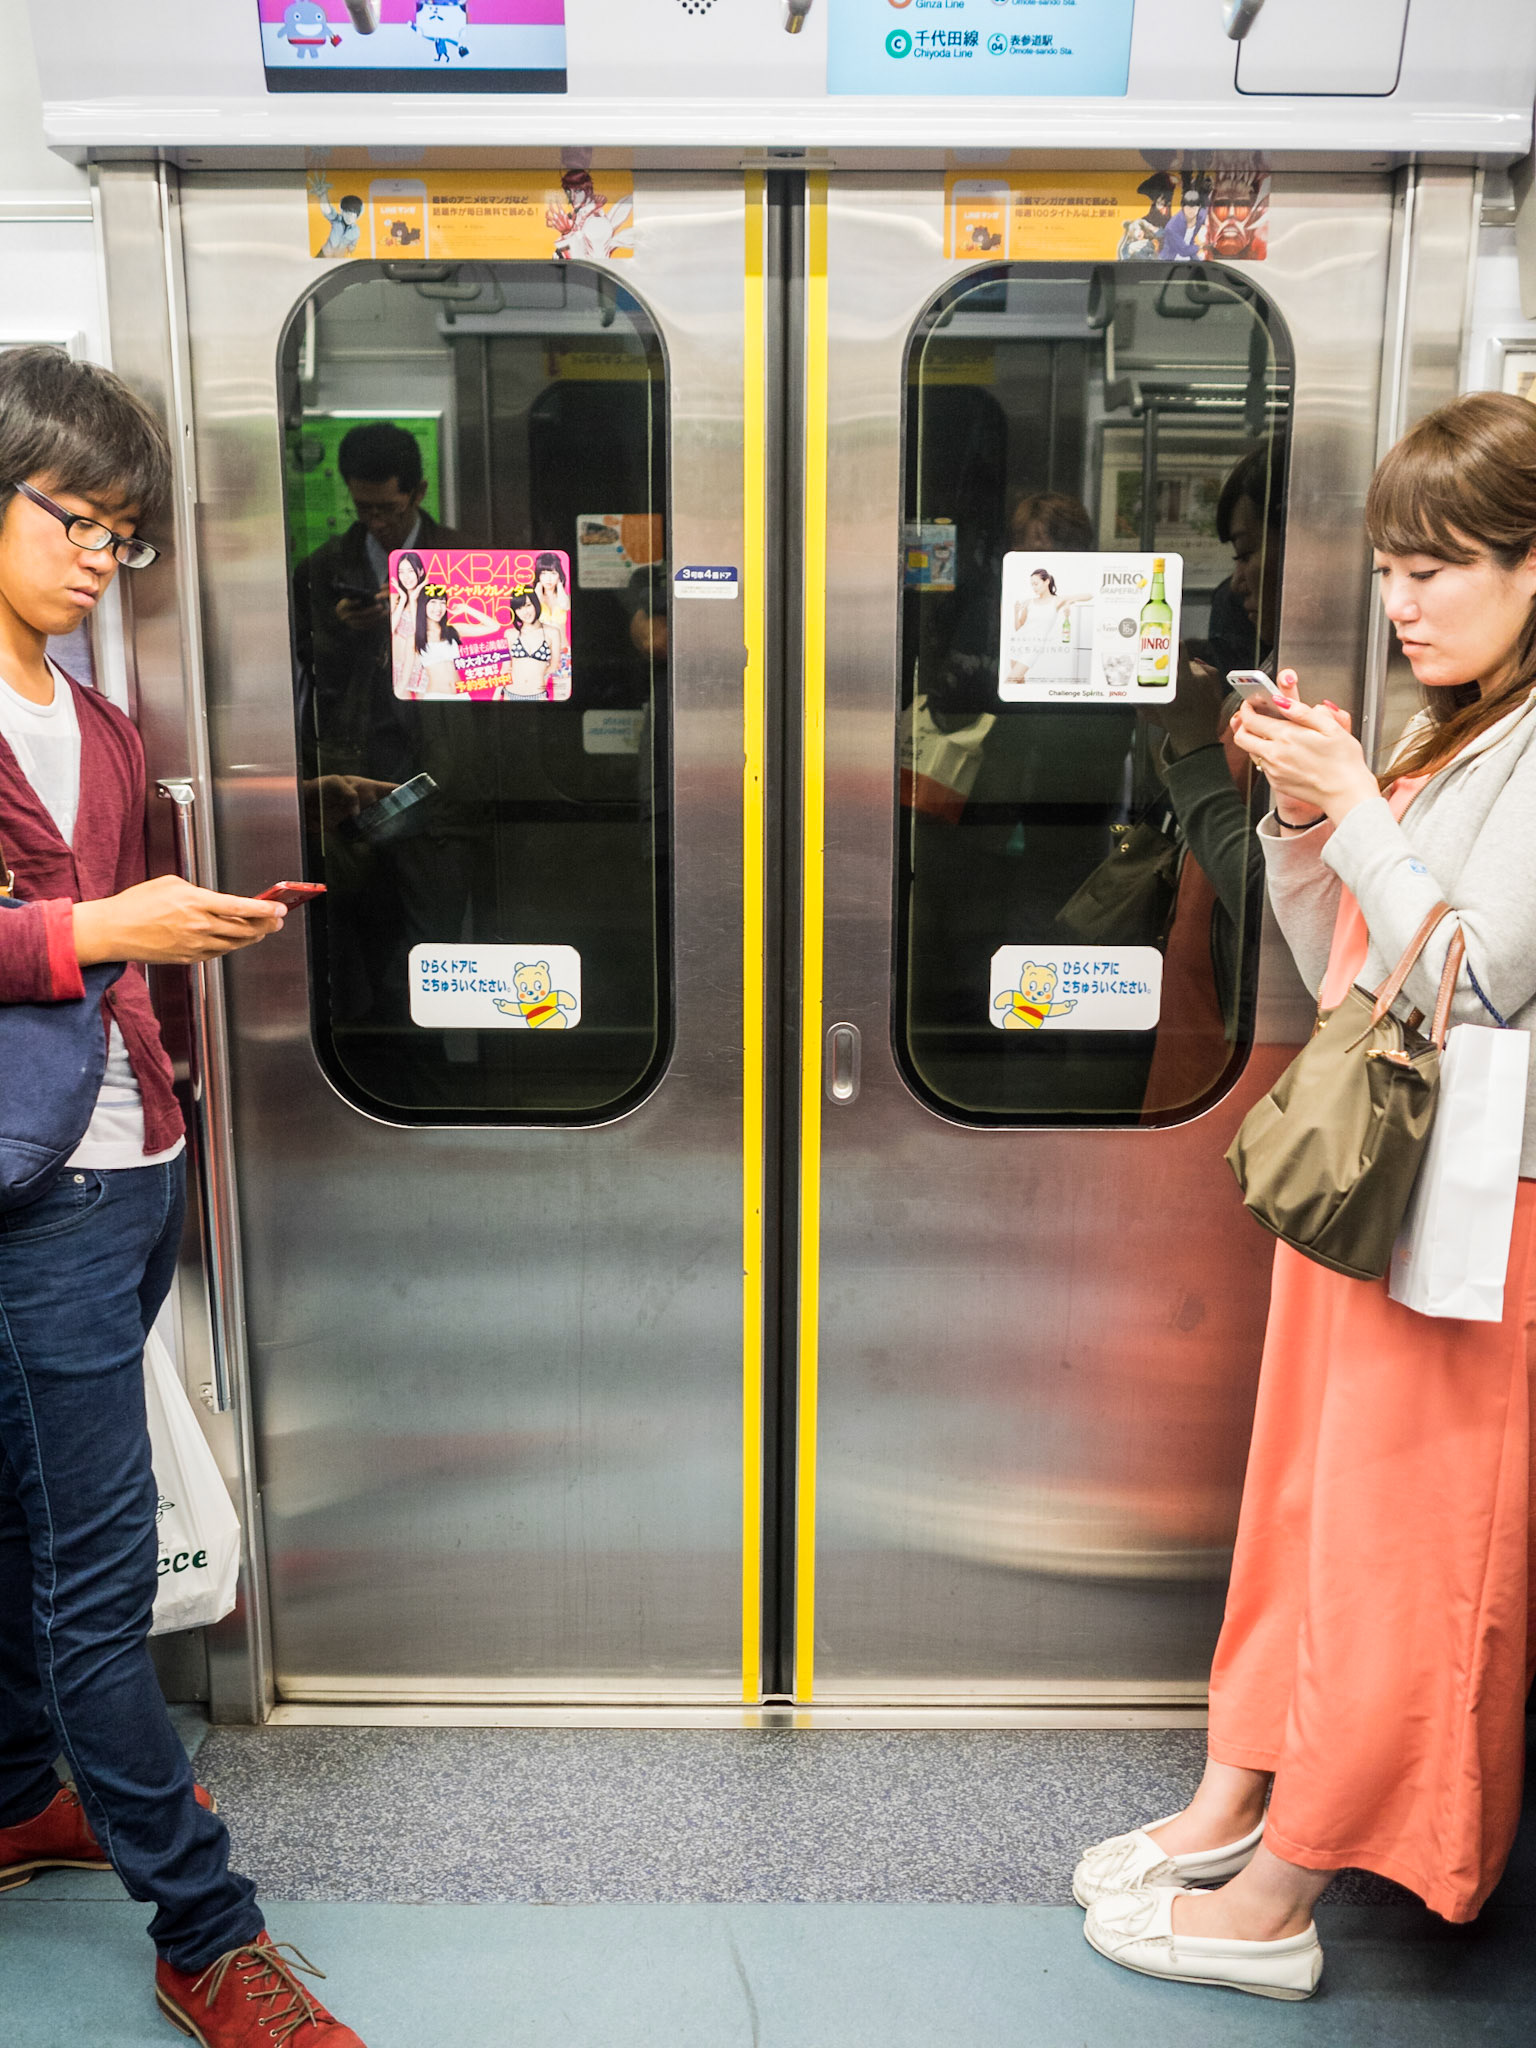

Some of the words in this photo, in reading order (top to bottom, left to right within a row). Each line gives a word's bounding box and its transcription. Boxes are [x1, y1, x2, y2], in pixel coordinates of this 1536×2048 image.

[915, 0, 942, 9] Ginza
[945, 0, 965, 9] Line
[894, 38, 902, 50] C
[914, 30, 979, 47] 千代田線
[1010, 34, 1053, 46] 表参道駅
[991, 42, 1003, 51] 04
[1009, 47, 1058, 55] Omote-sando
[914, 48, 951, 60] Chiyoda
[953, 48, 973, 58] Line
[432, 195, 529, 205] 最新のアニメ化マンガなど
[424, 553, 535, 585] AKB48
[1102, 573, 1144, 587] JINRO
[424, 584, 534, 597] オフィシャルカレンダー
[446, 596, 515, 627] 2015
[1141, 638, 1169, 652] JINRO
[1048, 690, 1080, 698] Challenge
[420, 959, 477, 973] ひらくドアに
[1062, 961, 1119, 975] ひらくドアに
[421, 979, 511, 993] ごちゅういください。
[1062, 980, 1151, 994] ごちゅういください。
[156, 1550, 208, 1577] cce
